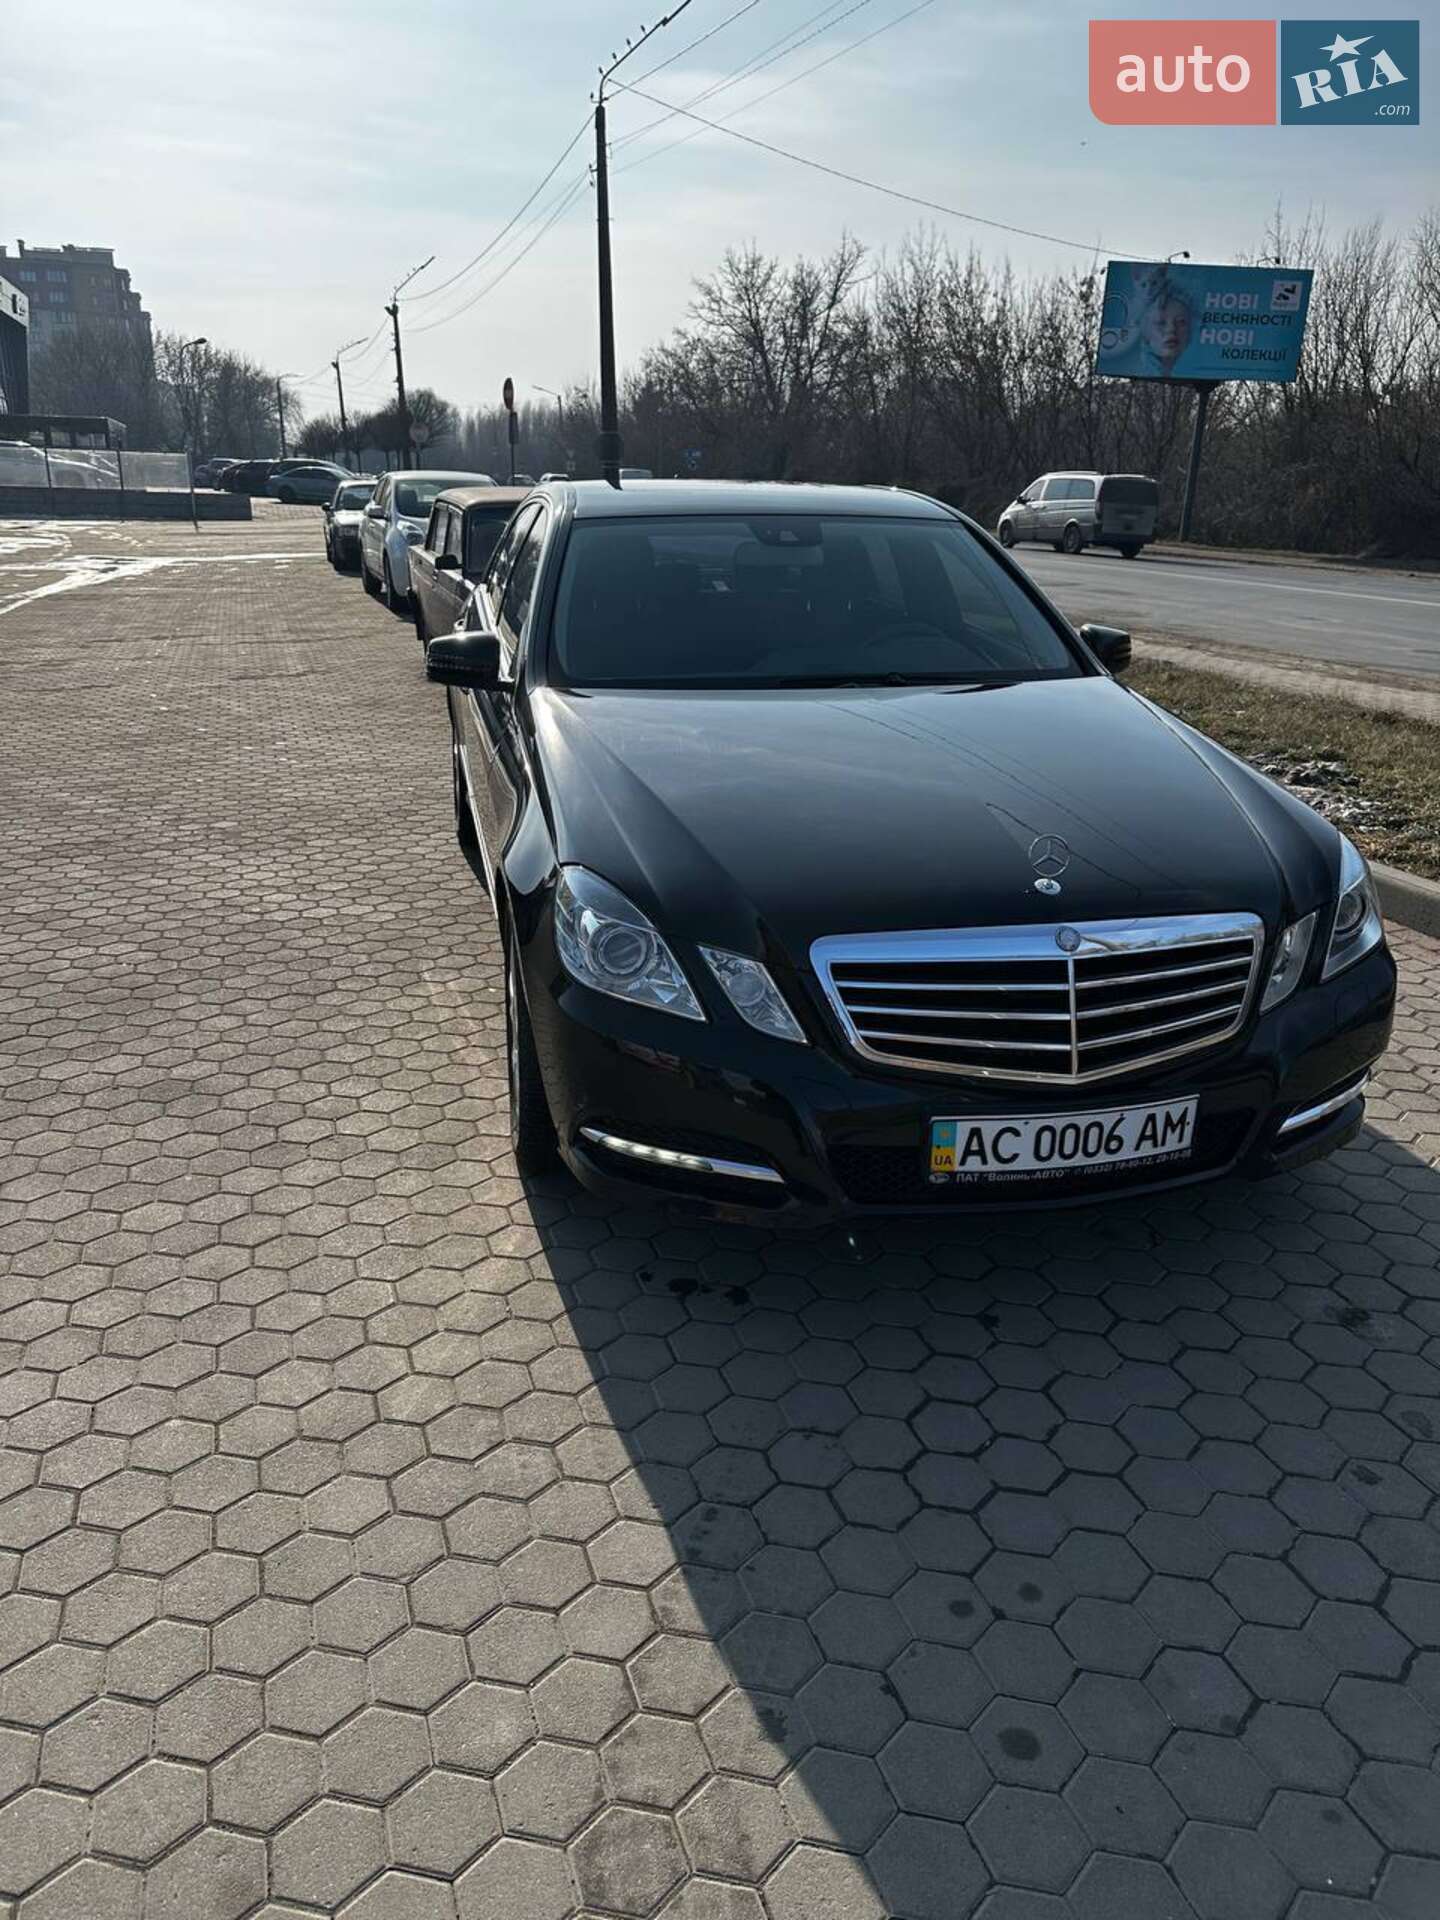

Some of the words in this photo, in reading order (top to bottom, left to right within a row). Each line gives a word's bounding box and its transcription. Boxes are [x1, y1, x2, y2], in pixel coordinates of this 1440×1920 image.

[1206, 292, 1259, 309] НОВІ
[1200, 328, 1255, 345] НОВІ
[959, 1126, 1021, 1166] AC
[1033, 1115, 1126, 1162] 0006
[1135, 1107, 1188, 1151] AM
[934, 1154, 952, 1166] UA
